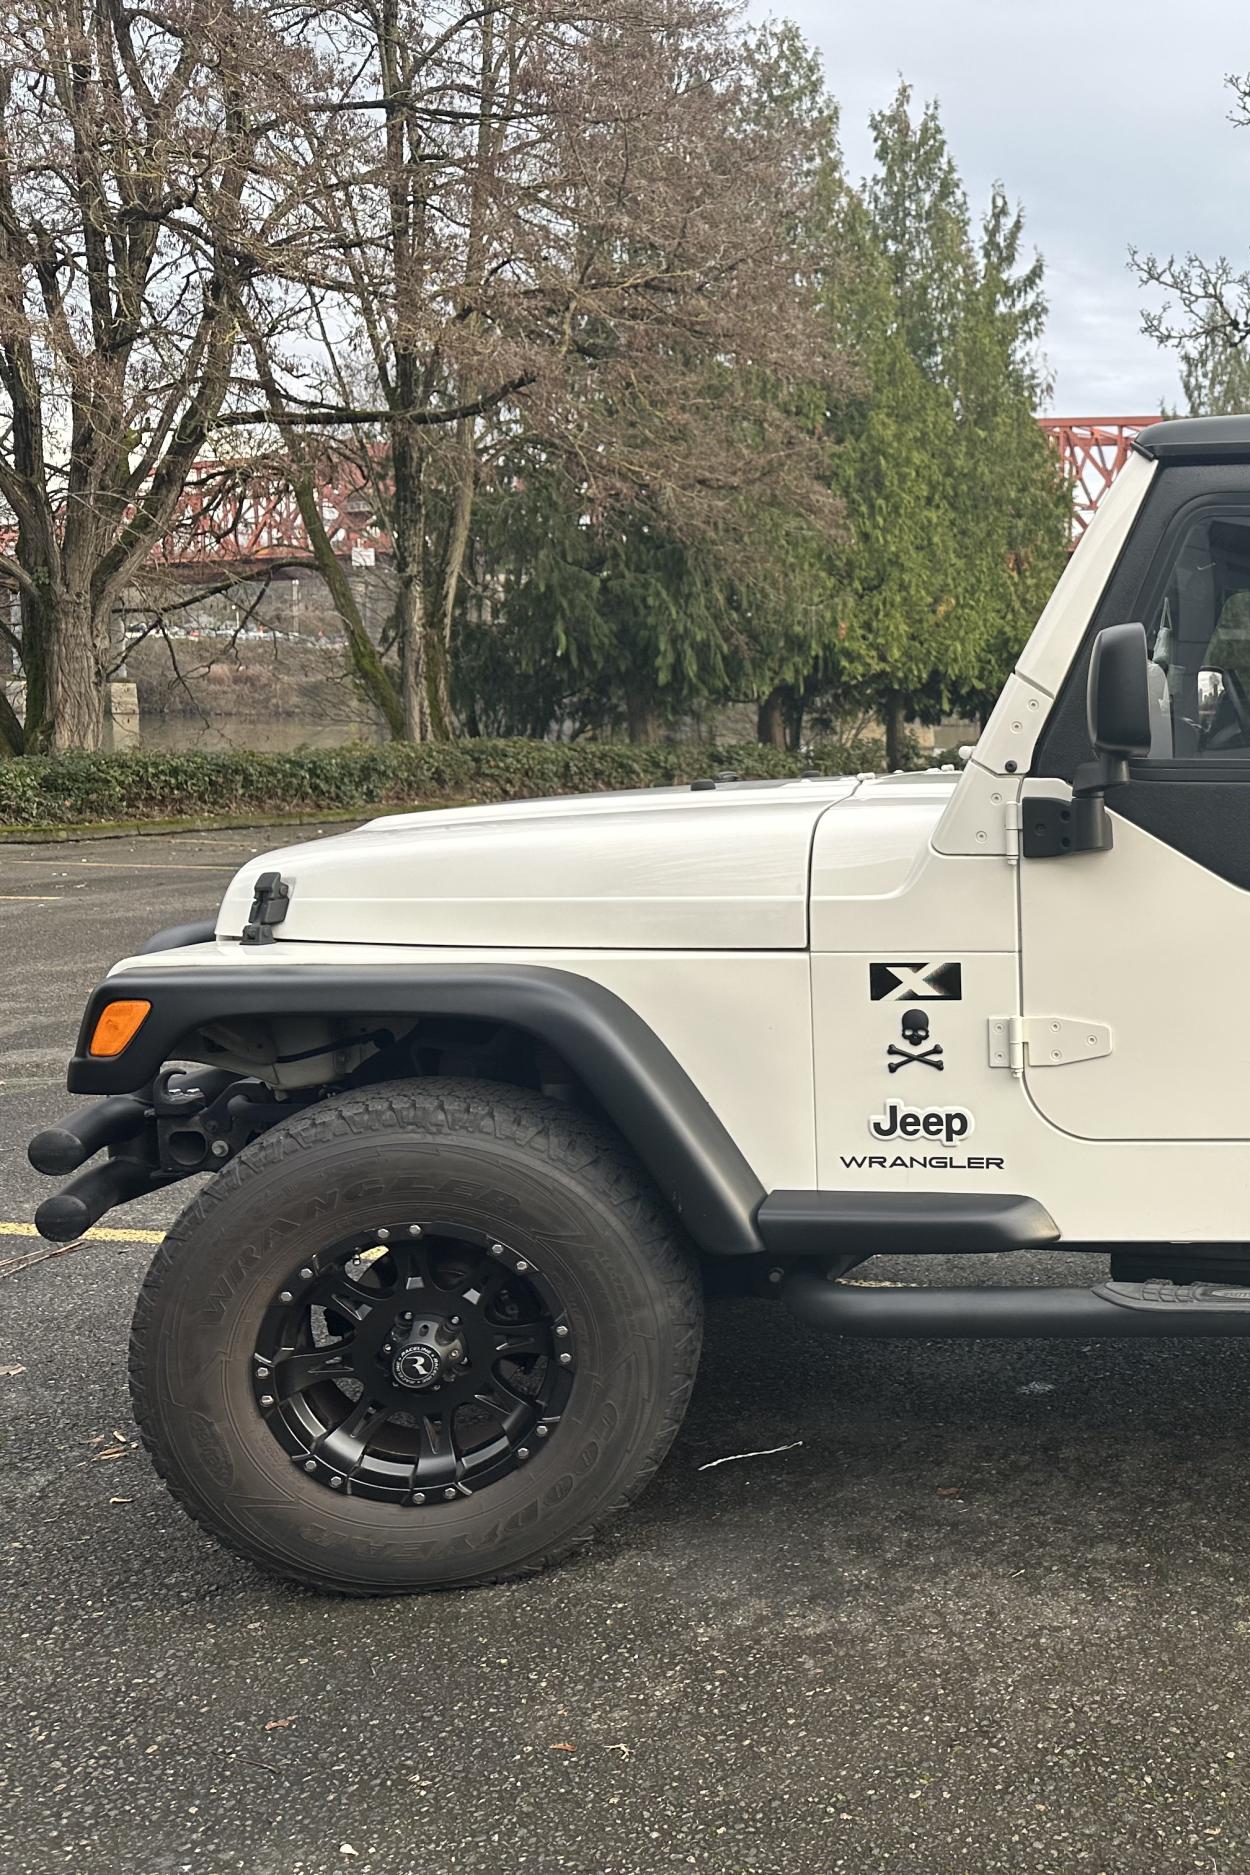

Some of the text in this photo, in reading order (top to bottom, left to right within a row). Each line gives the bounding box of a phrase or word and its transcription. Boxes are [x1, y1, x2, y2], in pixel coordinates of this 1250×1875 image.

[873, 1104, 969, 1143] Jeep
[839, 1155, 1006, 1170] WRANGLER
[201, 1177, 521, 1325] WRANGLER
